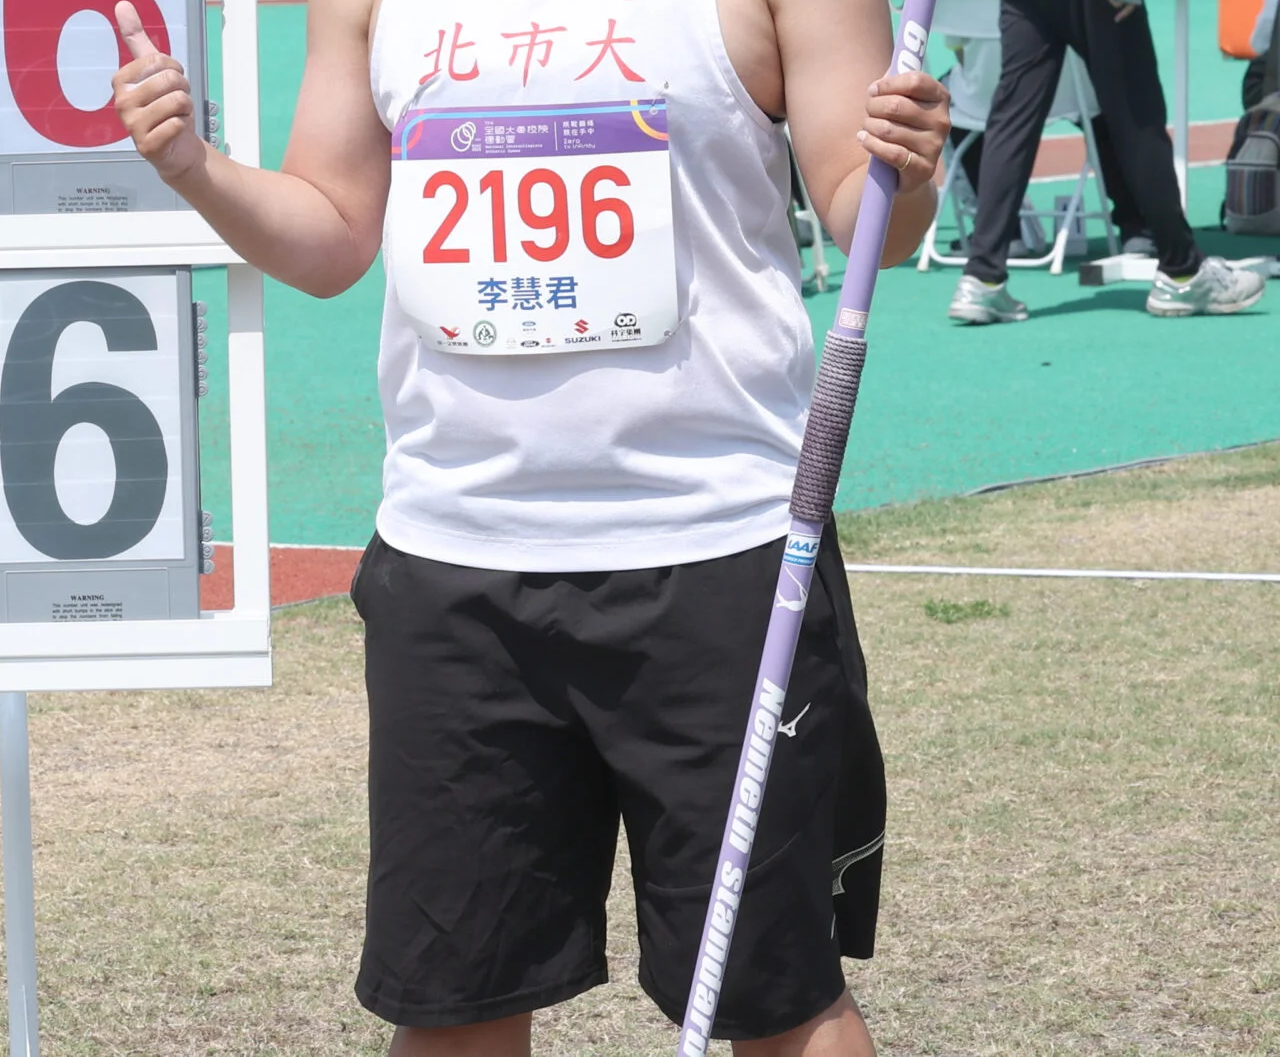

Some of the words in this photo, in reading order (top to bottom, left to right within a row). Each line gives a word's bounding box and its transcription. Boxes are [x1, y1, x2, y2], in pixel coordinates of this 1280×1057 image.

[418, 18, 646, 88] 北市大
[422, 164, 635, 264] 2196
[477, 275, 578, 312] 李慧君
[564, 335, 601, 344] SUZUKI
[728, 677, 787, 854] Nemeth
